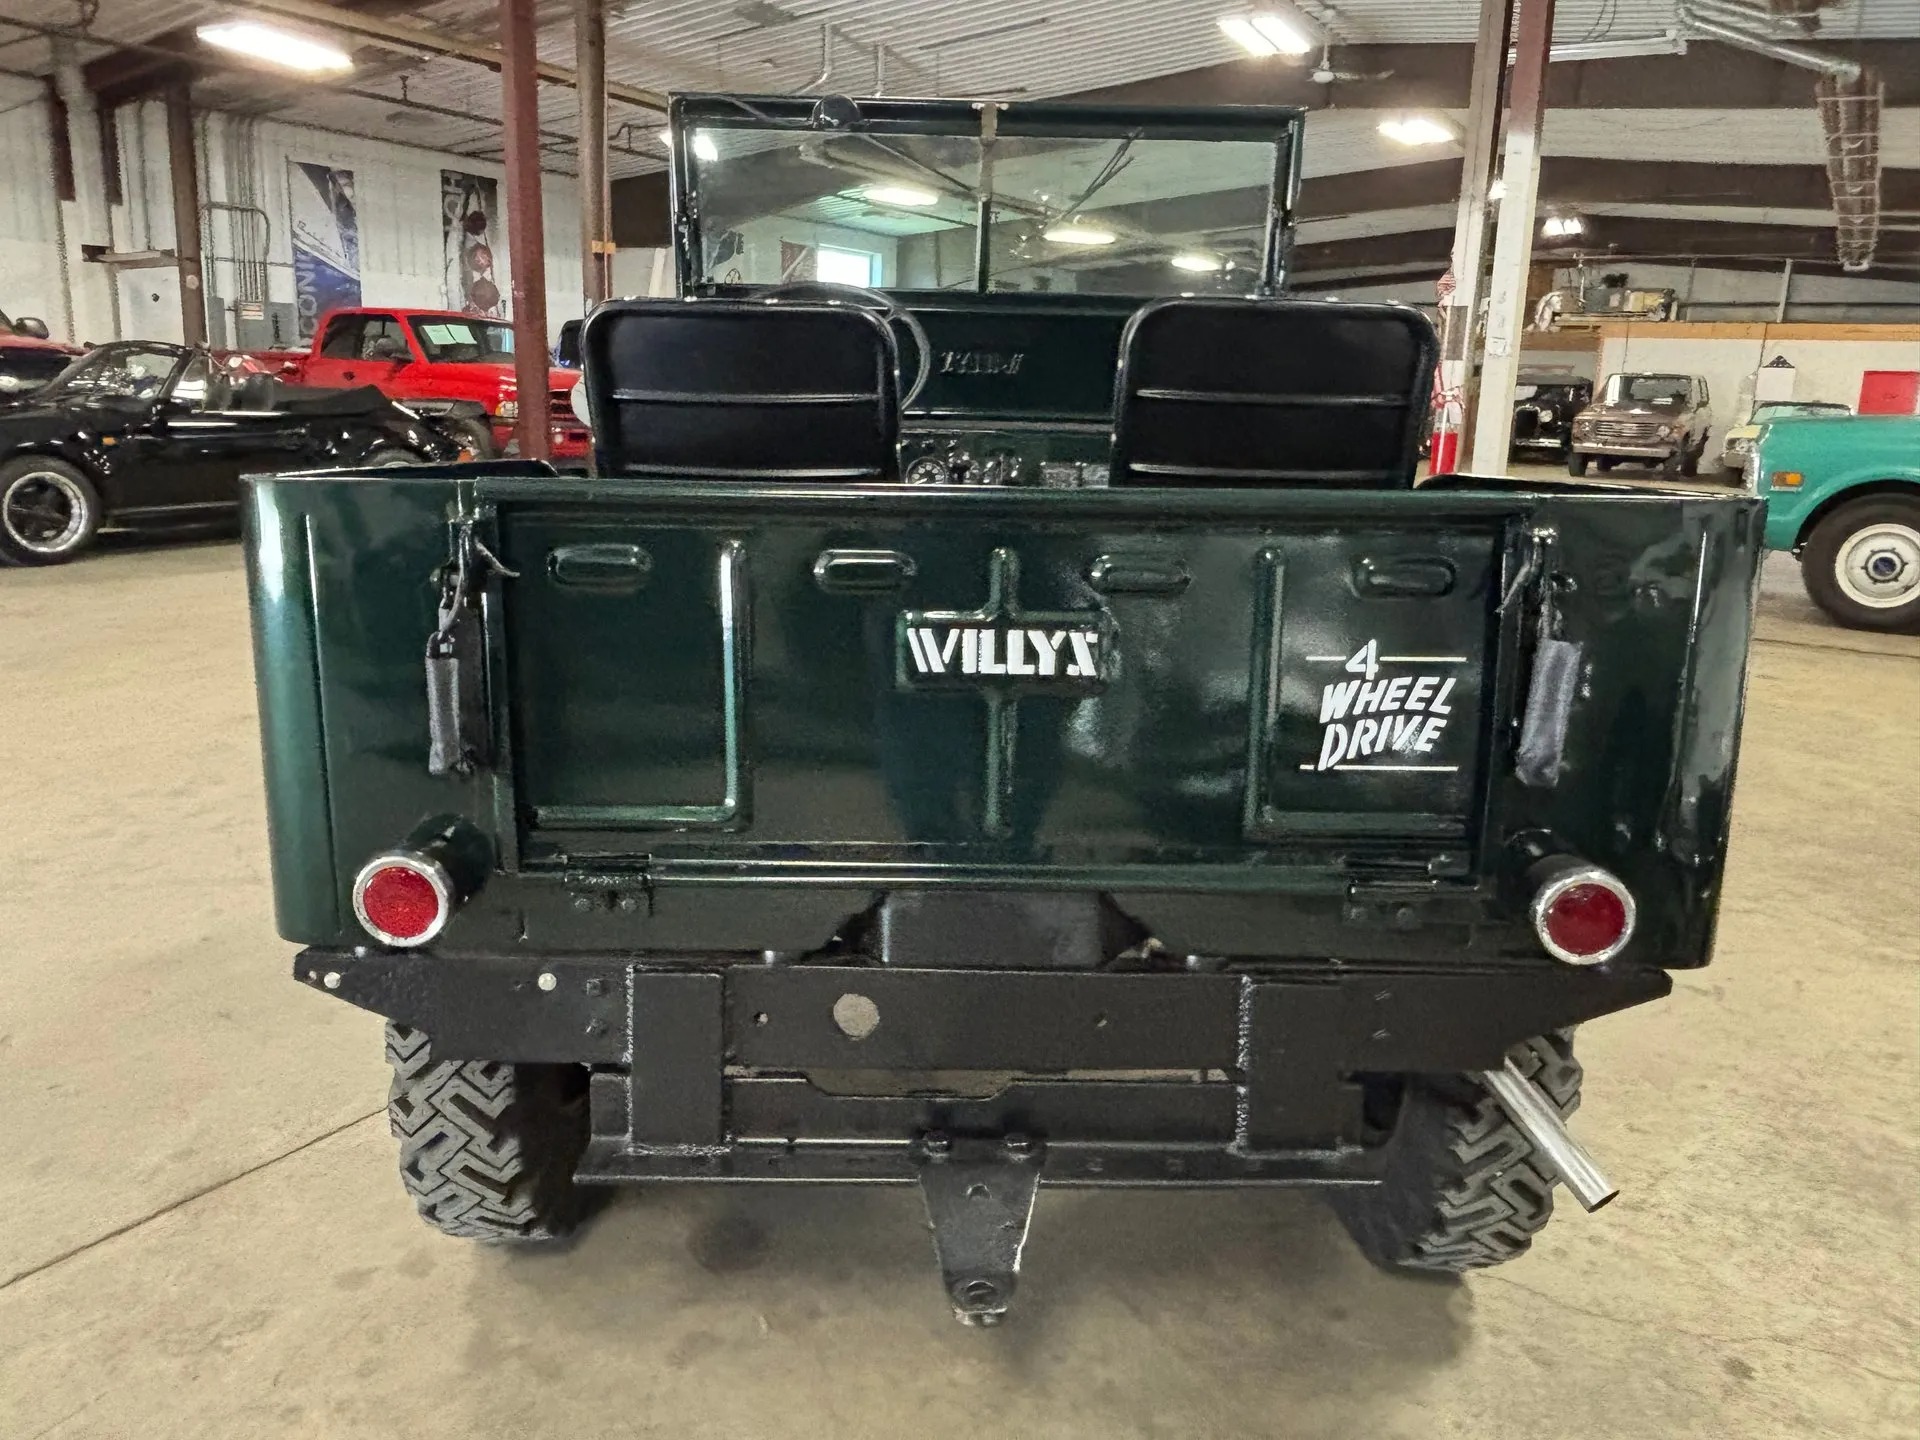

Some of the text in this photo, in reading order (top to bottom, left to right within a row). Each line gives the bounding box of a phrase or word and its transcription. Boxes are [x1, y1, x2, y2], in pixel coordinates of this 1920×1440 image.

[906, 628, 1099, 676] WILLYS
[1345, 638, 1379, 681] 4
[1319, 676, 1457, 724] WHEEL
[1317, 714, 1448, 771] DRIVE
